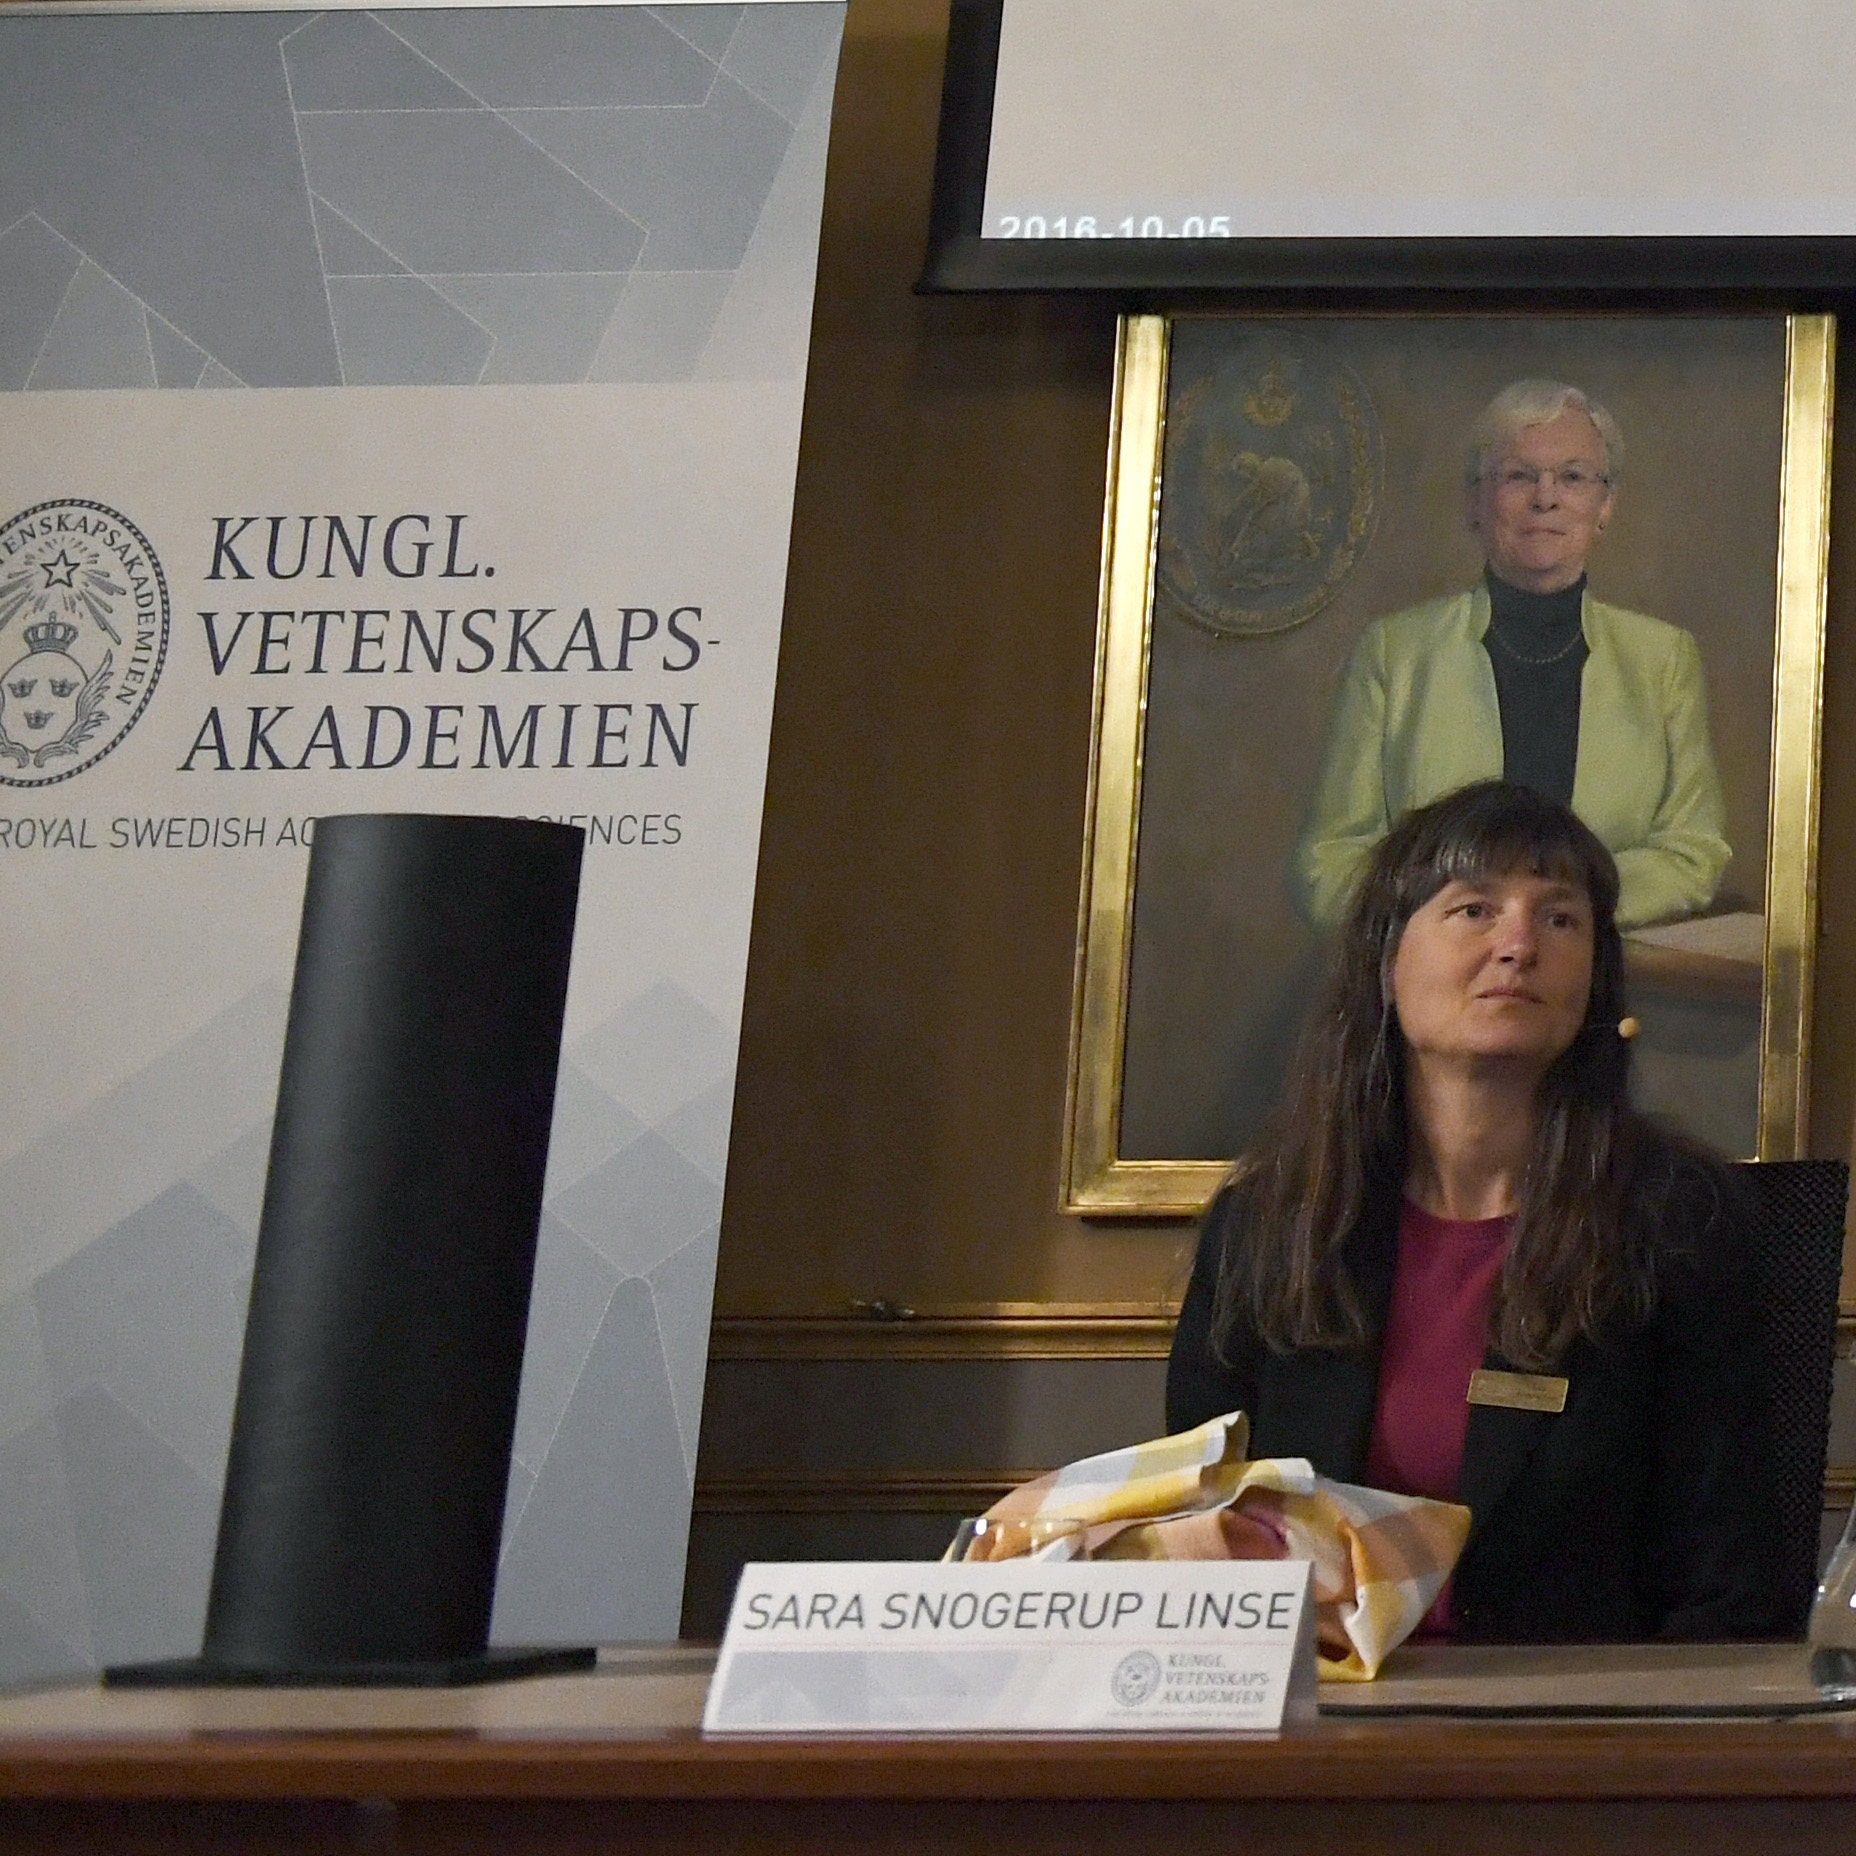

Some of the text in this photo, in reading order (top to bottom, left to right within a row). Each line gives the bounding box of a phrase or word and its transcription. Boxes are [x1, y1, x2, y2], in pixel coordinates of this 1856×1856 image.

[999, 215, 1231, 239] 2016-10-05
[204, 513, 497, 581] KUNGL.
[0, 512, 157, 706] ENSKAPSAKADEMIEN
[197, 606, 721, 677] VETENSKAPS-
[176, 703, 699, 772] AKADEMIEN
[109, 817, 267, 848] SWEDISH
[744, 1591, 1296, 1630] SARA SNOGERUP LINSE
